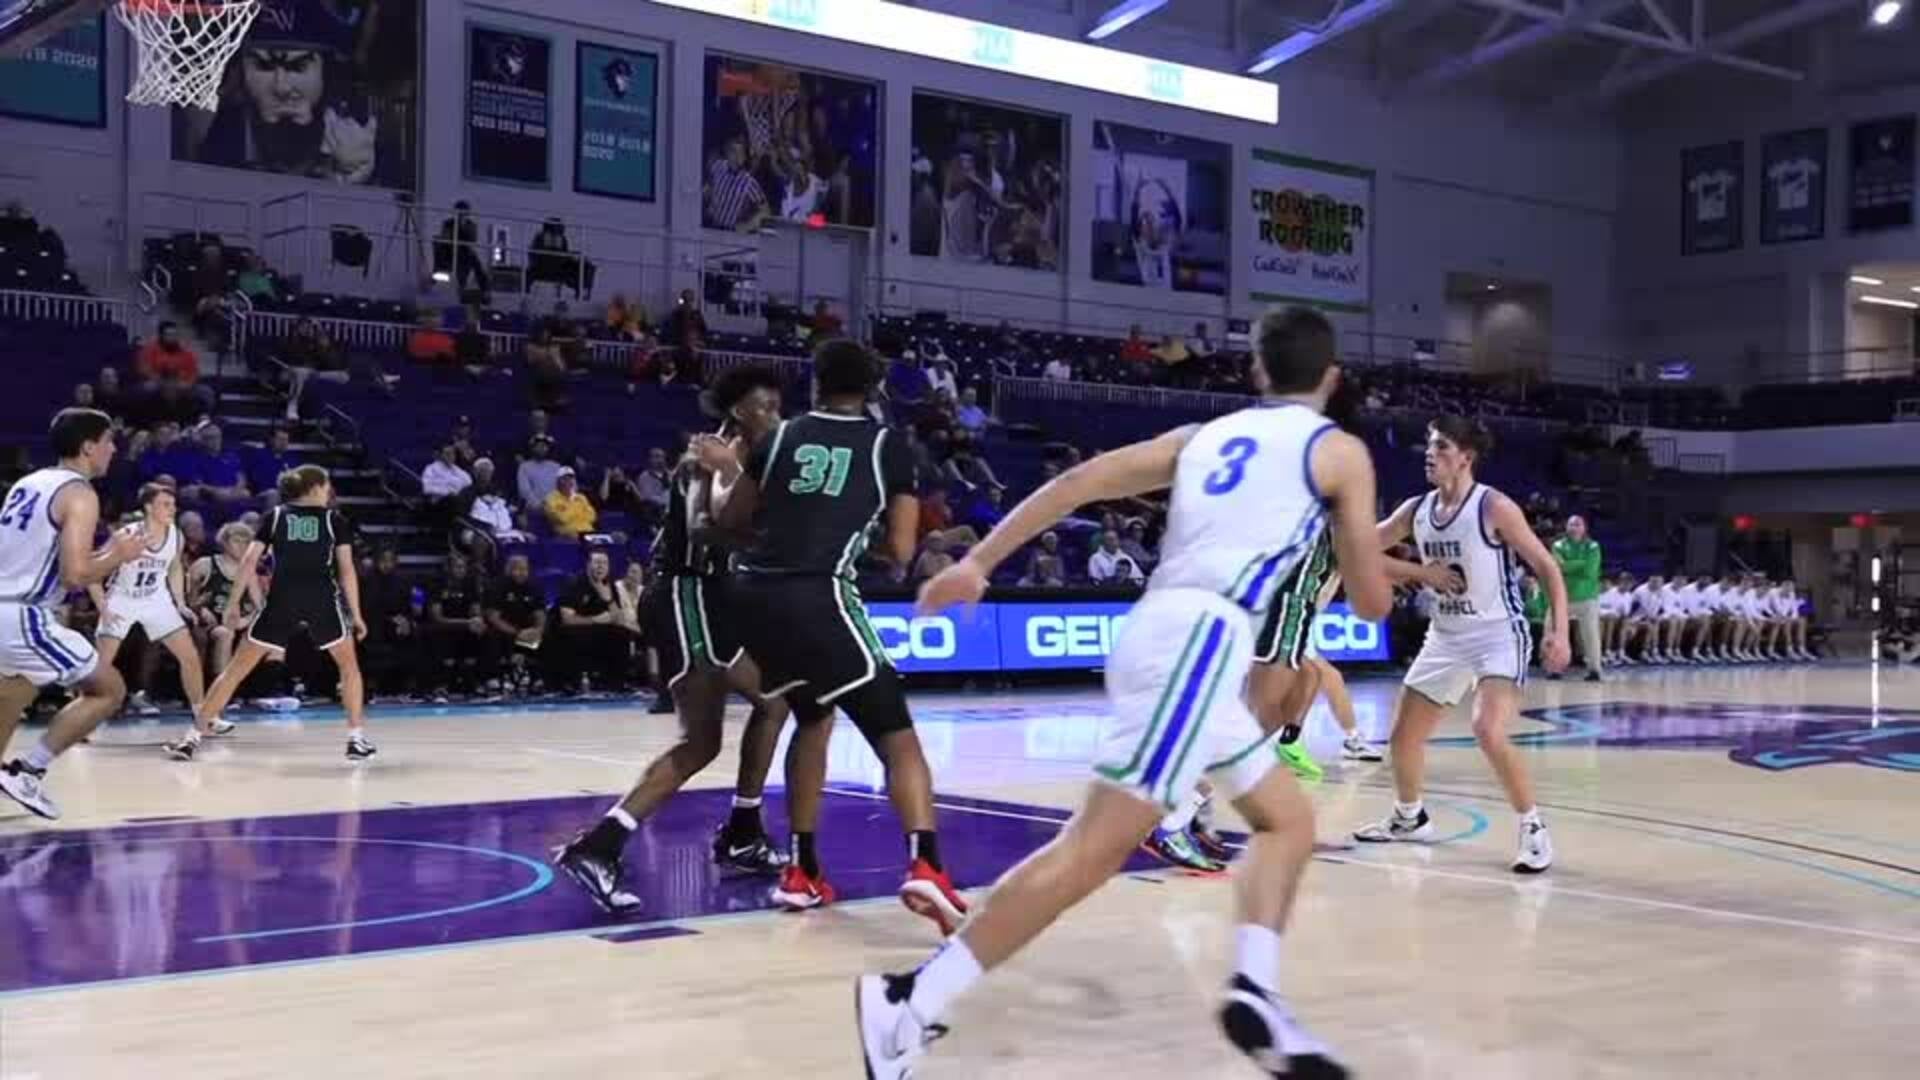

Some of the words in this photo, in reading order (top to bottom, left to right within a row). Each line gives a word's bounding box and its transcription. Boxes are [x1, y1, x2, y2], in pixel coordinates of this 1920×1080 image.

[1251, 188, 1364, 231] CROWTHER
[1259, 219, 1352, 256] ROOFING
[788, 444, 853, 497] 31
[1203, 436, 1257, 496] 3
[0, 487, 41, 531] 24
[286, 513, 319, 542] 10
[1026, 614, 1128, 658] GEI
